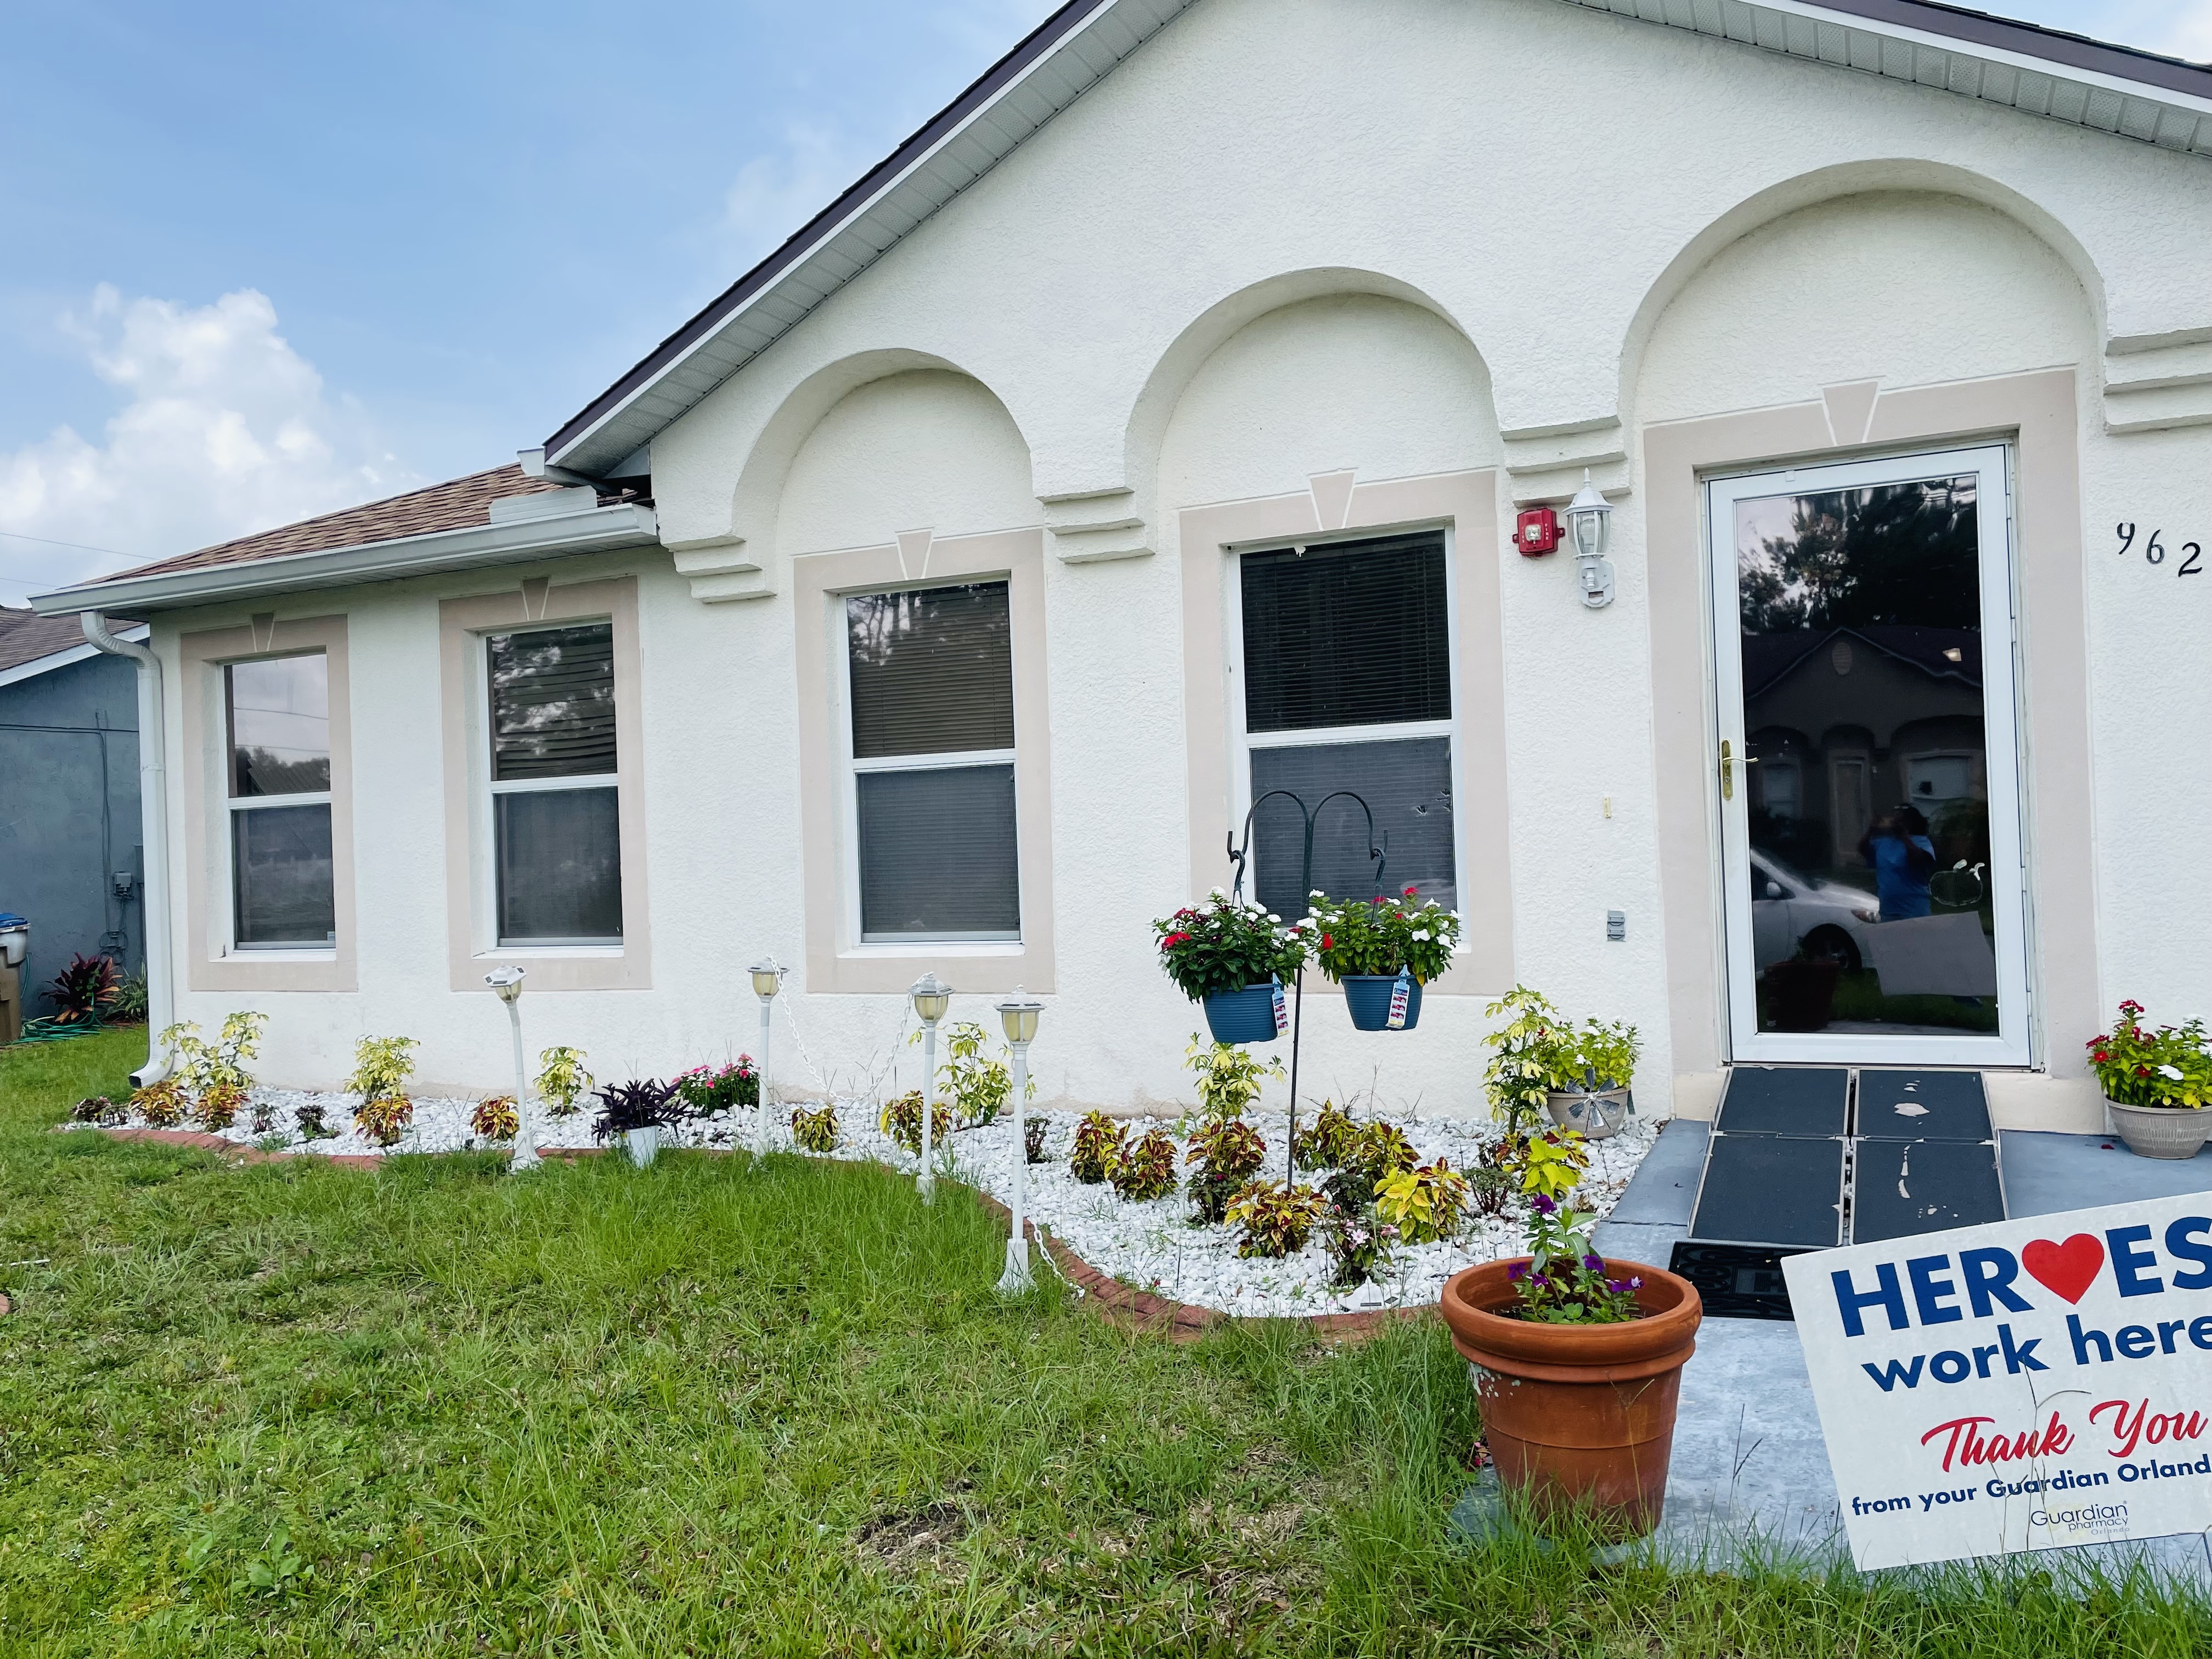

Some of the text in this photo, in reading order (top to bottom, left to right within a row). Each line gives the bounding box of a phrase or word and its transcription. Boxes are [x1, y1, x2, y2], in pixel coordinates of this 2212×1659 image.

[2117, 522, 2203, 577] 962
[1831, 1216, 2212, 1338] HERES
[1860, 1314, 2212, 1392] work here
[1921, 1398, 2209, 1473] Thank You
[1852, 1453, 2212, 1516] from your Guardian Orland
[2068, 1517, 2129, 1533] pharmacy
[2091, 1526, 2130, 1536] Orlando
